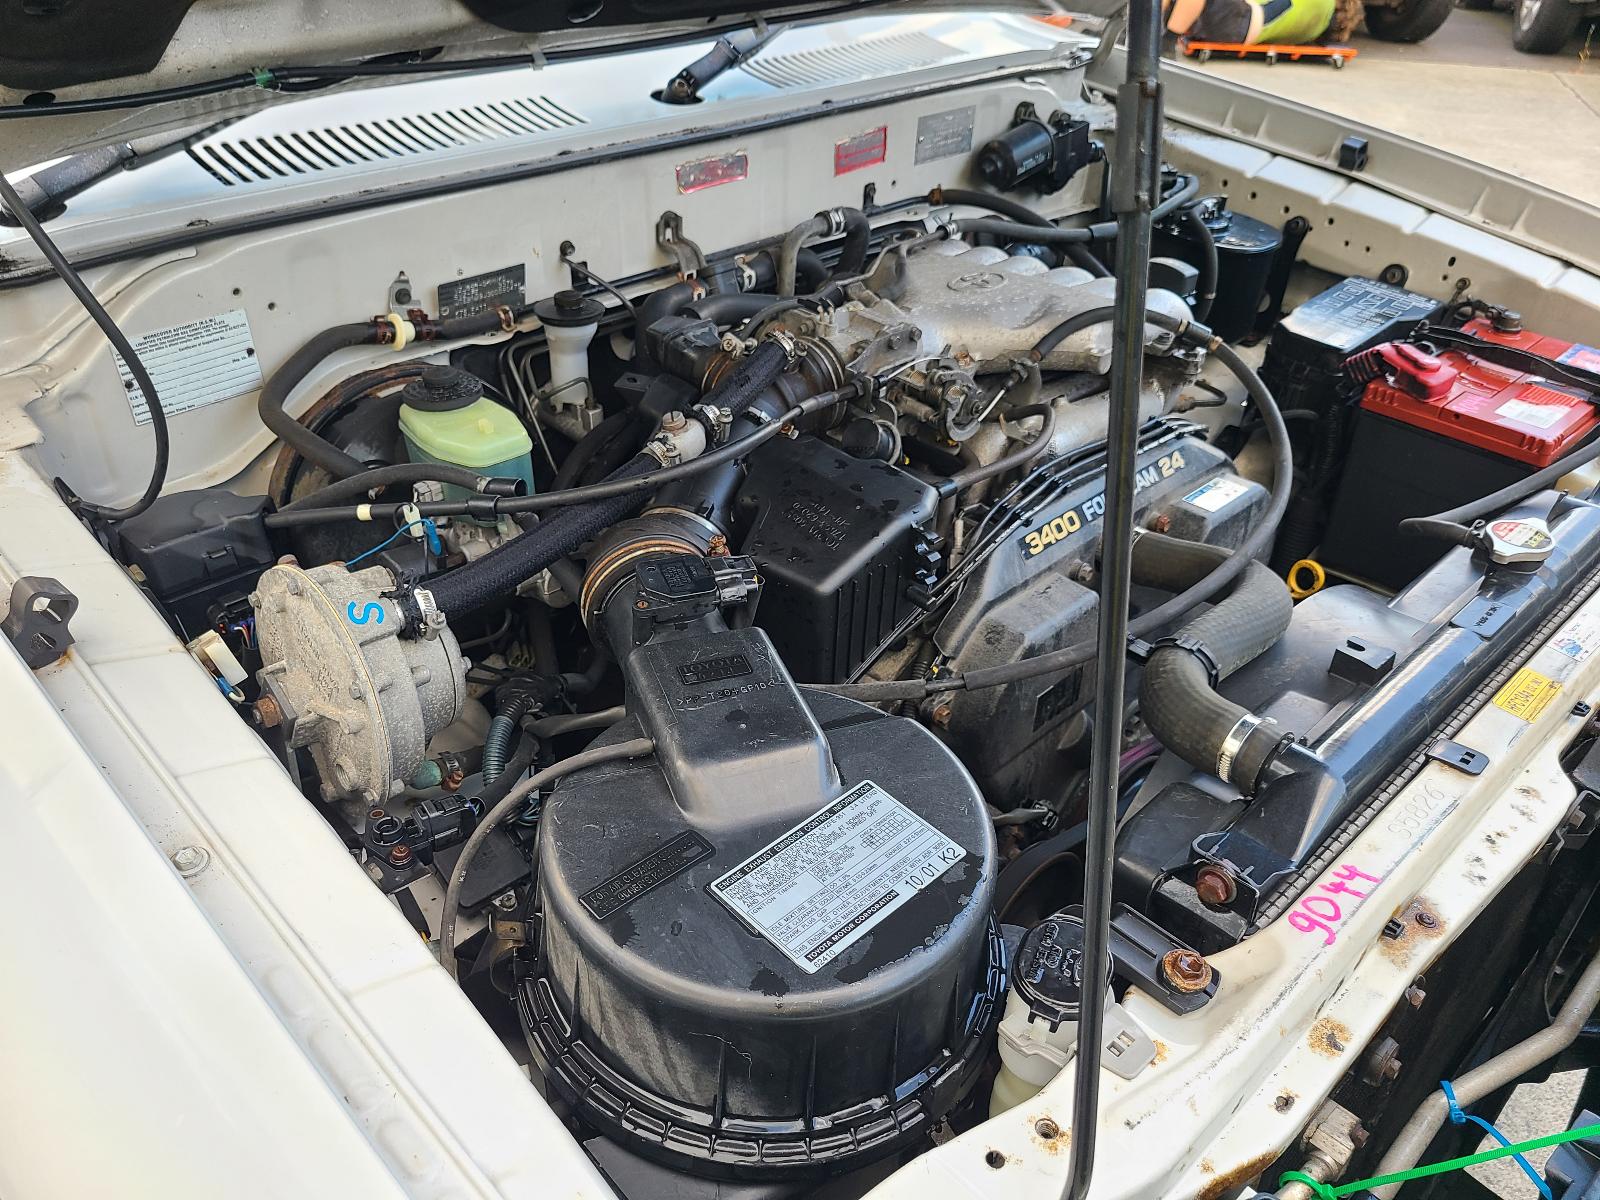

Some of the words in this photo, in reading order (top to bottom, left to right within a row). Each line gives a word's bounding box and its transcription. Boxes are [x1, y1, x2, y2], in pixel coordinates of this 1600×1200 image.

[1025, 509, 1082, 556] 3400
[1081, 494, 1107, 522] FO
[1134, 465, 1160, 494] AM
[1157, 450, 1185, 478] 24
[347, 601, 384, 626] S
[717, 871, 745, 890] ENGINE
[743, 851, 773, 873] EXHAUST
[773, 830, 805, 852] EMISSION
[802, 810, 834, 832] CONTROL
[831, 784, 872, 812] INFORMATION
[606, 878, 625, 893] AIR
[620, 856, 662, 885] CLEANER
[725, 877, 751, 895] ENGINE
[749, 862, 773, 879] FAMILY
[729, 881, 755, 899] ENGINE
[753, 863, 781, 882] TUNE-UP
[902, 862, 941, 891] 10/01
[936, 846, 962, 865] K2
[750, 896, 777, 915] IGNITION
[775, 881, 799, 898] TIMING
[769, 921, 784, 933] IDLE
[783, 904, 808, 923] MIXTURE
[807, 888, 830, 906] SETTING
[828, 882, 839, 890] CO
[793, 944, 809, 956] THIS
[807, 928, 829, 946] ENGINE
[827, 918, 842, 930] WAS
[840, 889, 882, 921] MANUFACTURED
[879, 883, 890, 891] TO
[888, 868, 910, 885] COMPLY
[908, 858, 924, 869] WITH
[821, 915, 833, 924] NO
[832, 900, 853, 916] OTHER
[852, 873, 890, 901] ADJUSTMENTS
[1288, 864, 1383, 948] 9044
[782, 928, 801, 943] SPARK
[801, 917, 817, 929] PLUG
[816, 908, 829, 918] GAP
[806, 939, 834, 961] TOYOTA
[830, 922, 857, 943] MOTOR
[853, 890, 899, 925] CORPORATION
